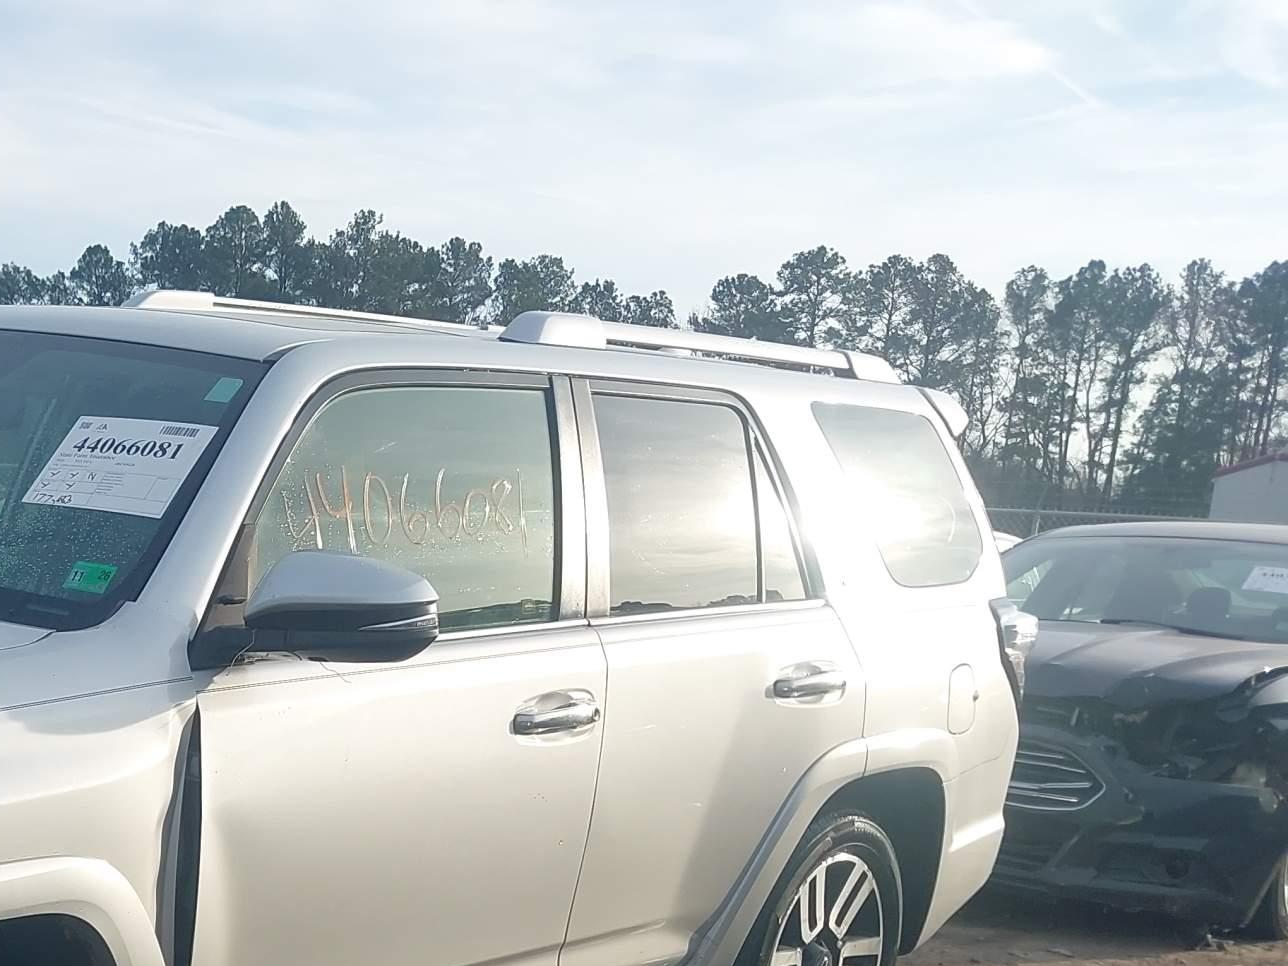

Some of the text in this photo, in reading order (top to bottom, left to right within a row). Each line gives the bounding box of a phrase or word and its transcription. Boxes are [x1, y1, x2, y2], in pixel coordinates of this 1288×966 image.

[73, 436, 184, 460] 44066081
[280, 465, 529, 557] 44066081
[71, 570, 111, 582] 11 26
